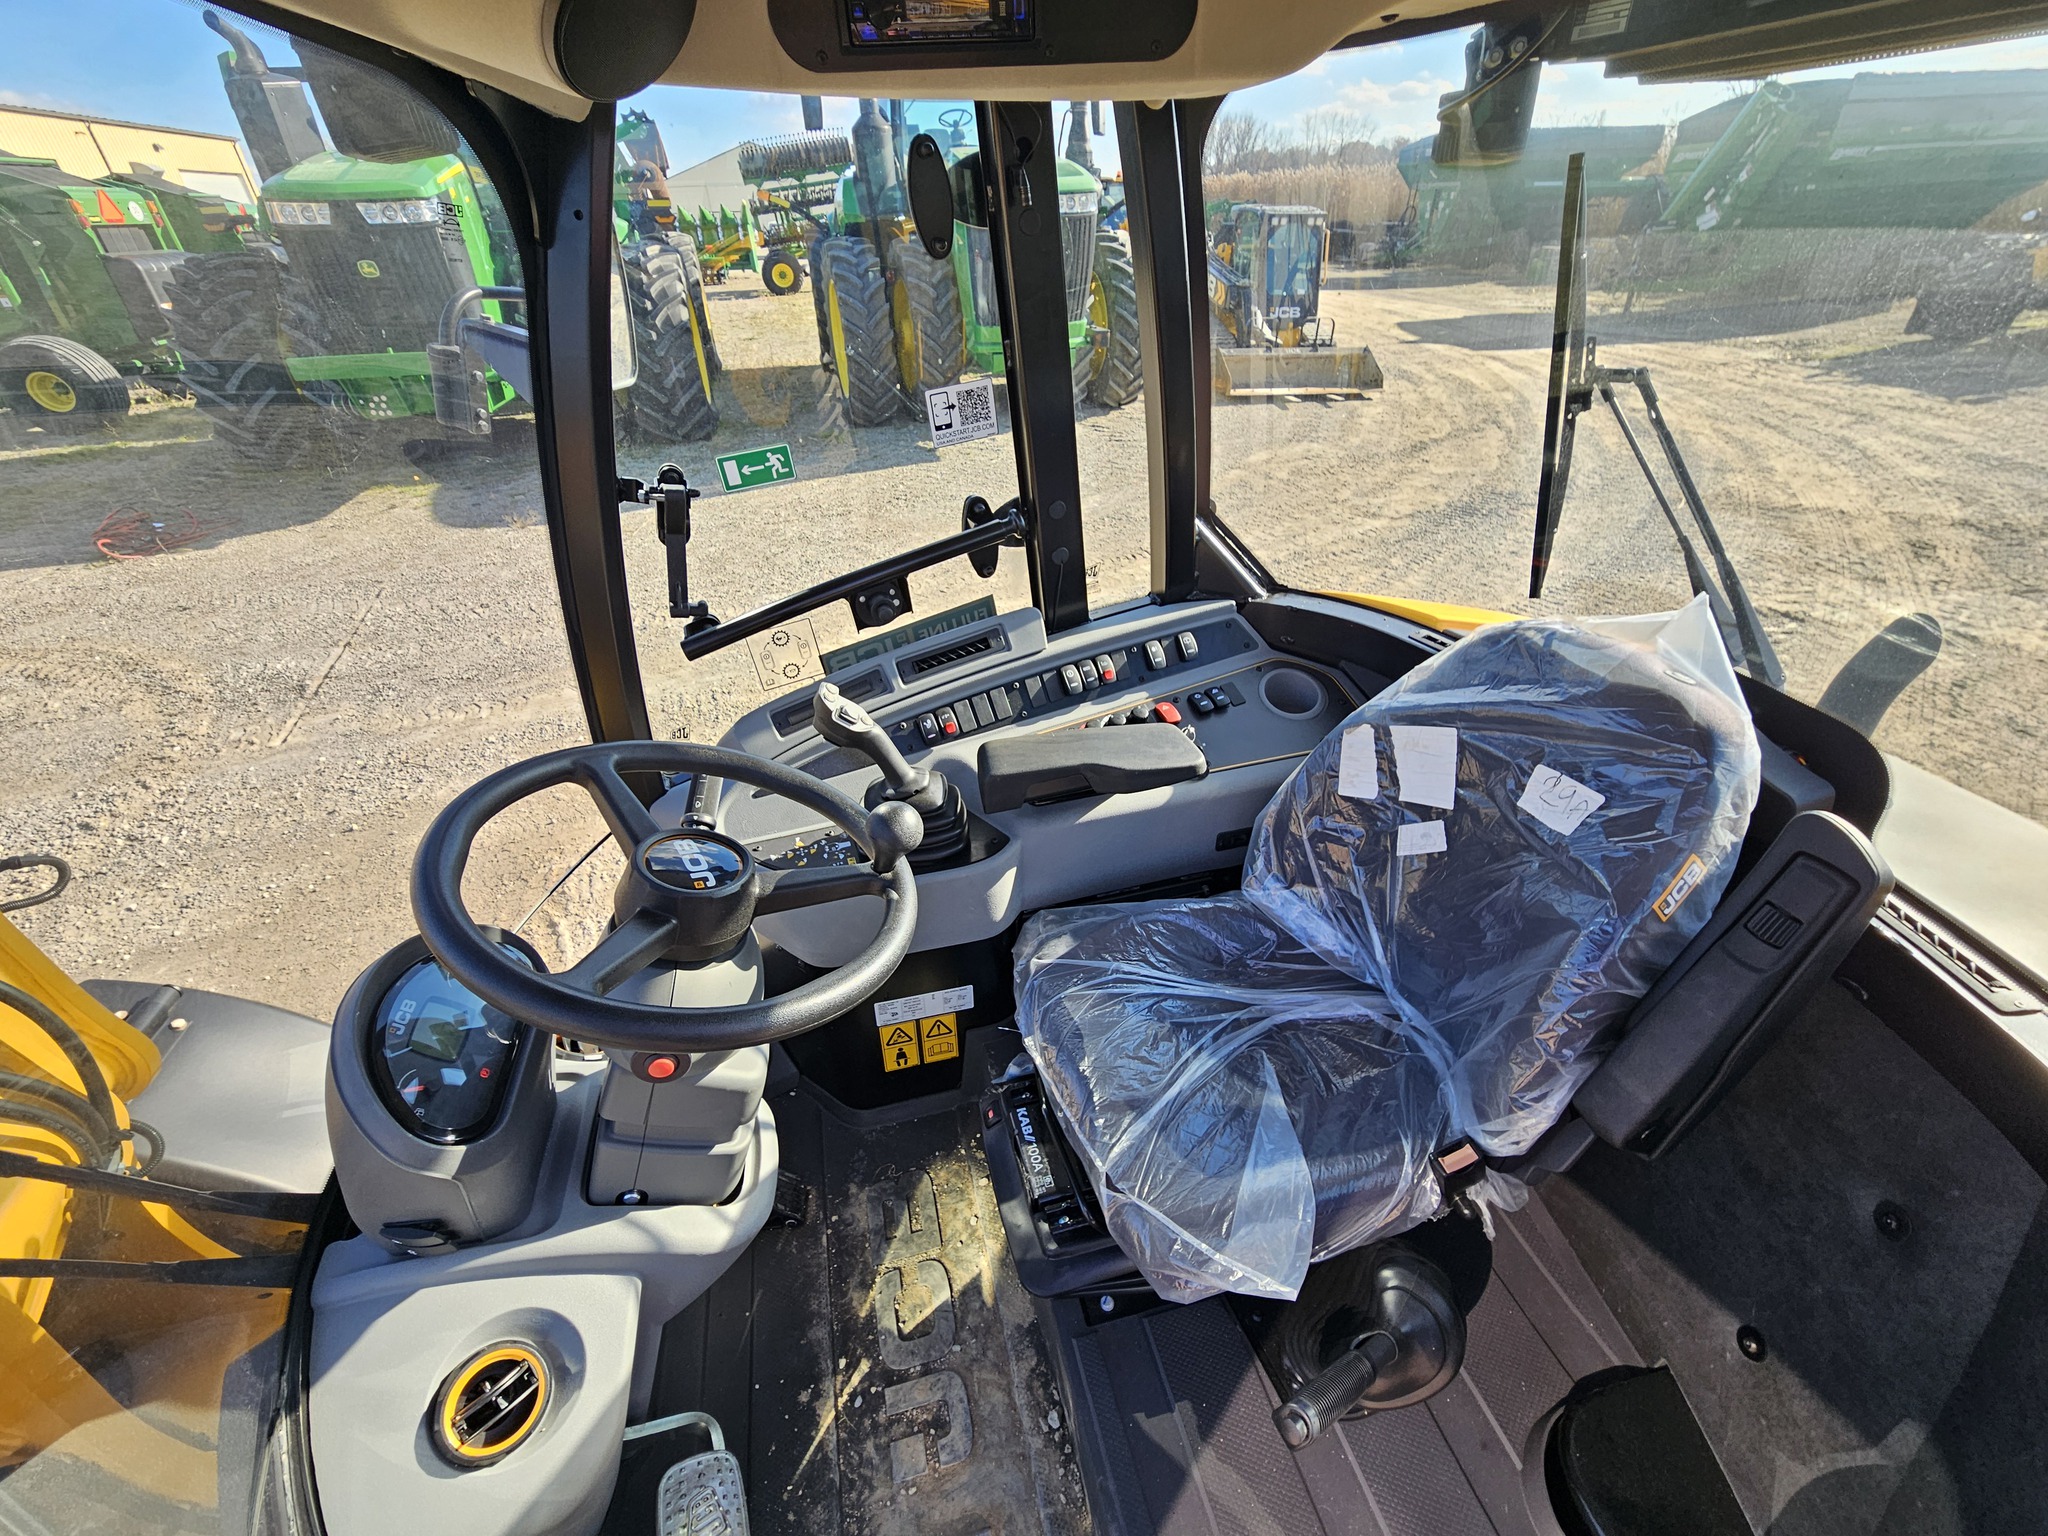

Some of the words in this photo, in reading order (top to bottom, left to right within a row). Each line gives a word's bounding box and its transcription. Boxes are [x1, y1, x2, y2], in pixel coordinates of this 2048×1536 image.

[1270, 306, 1300, 318] JCB
[673, 839, 717, 887] JCB
[1663, 862, 1701, 915] JCB
[395, 999, 417, 1036] JCB
[867, 1169, 973, 1484] JCB
